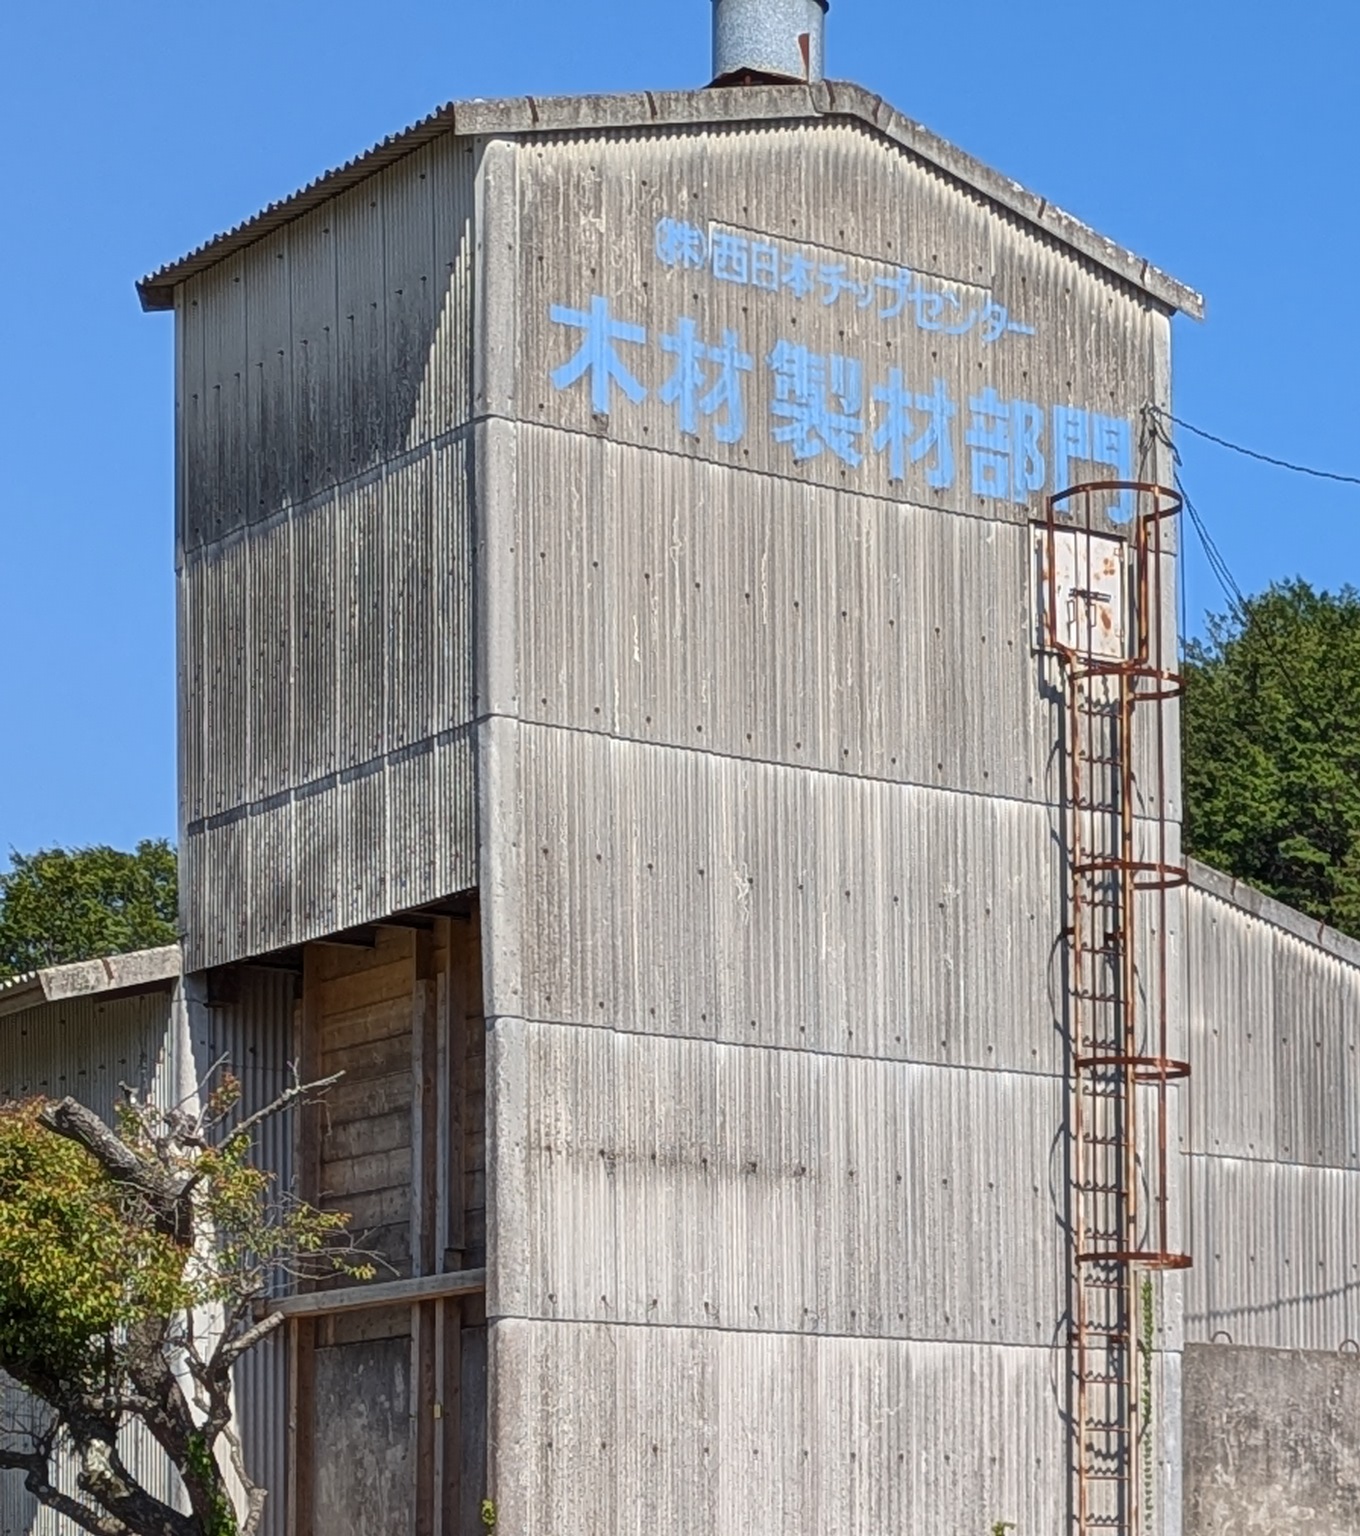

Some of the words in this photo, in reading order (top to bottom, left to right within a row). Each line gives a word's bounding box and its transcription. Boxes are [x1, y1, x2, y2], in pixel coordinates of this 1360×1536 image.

[549, 294, 1137, 525] 木材製材部門
